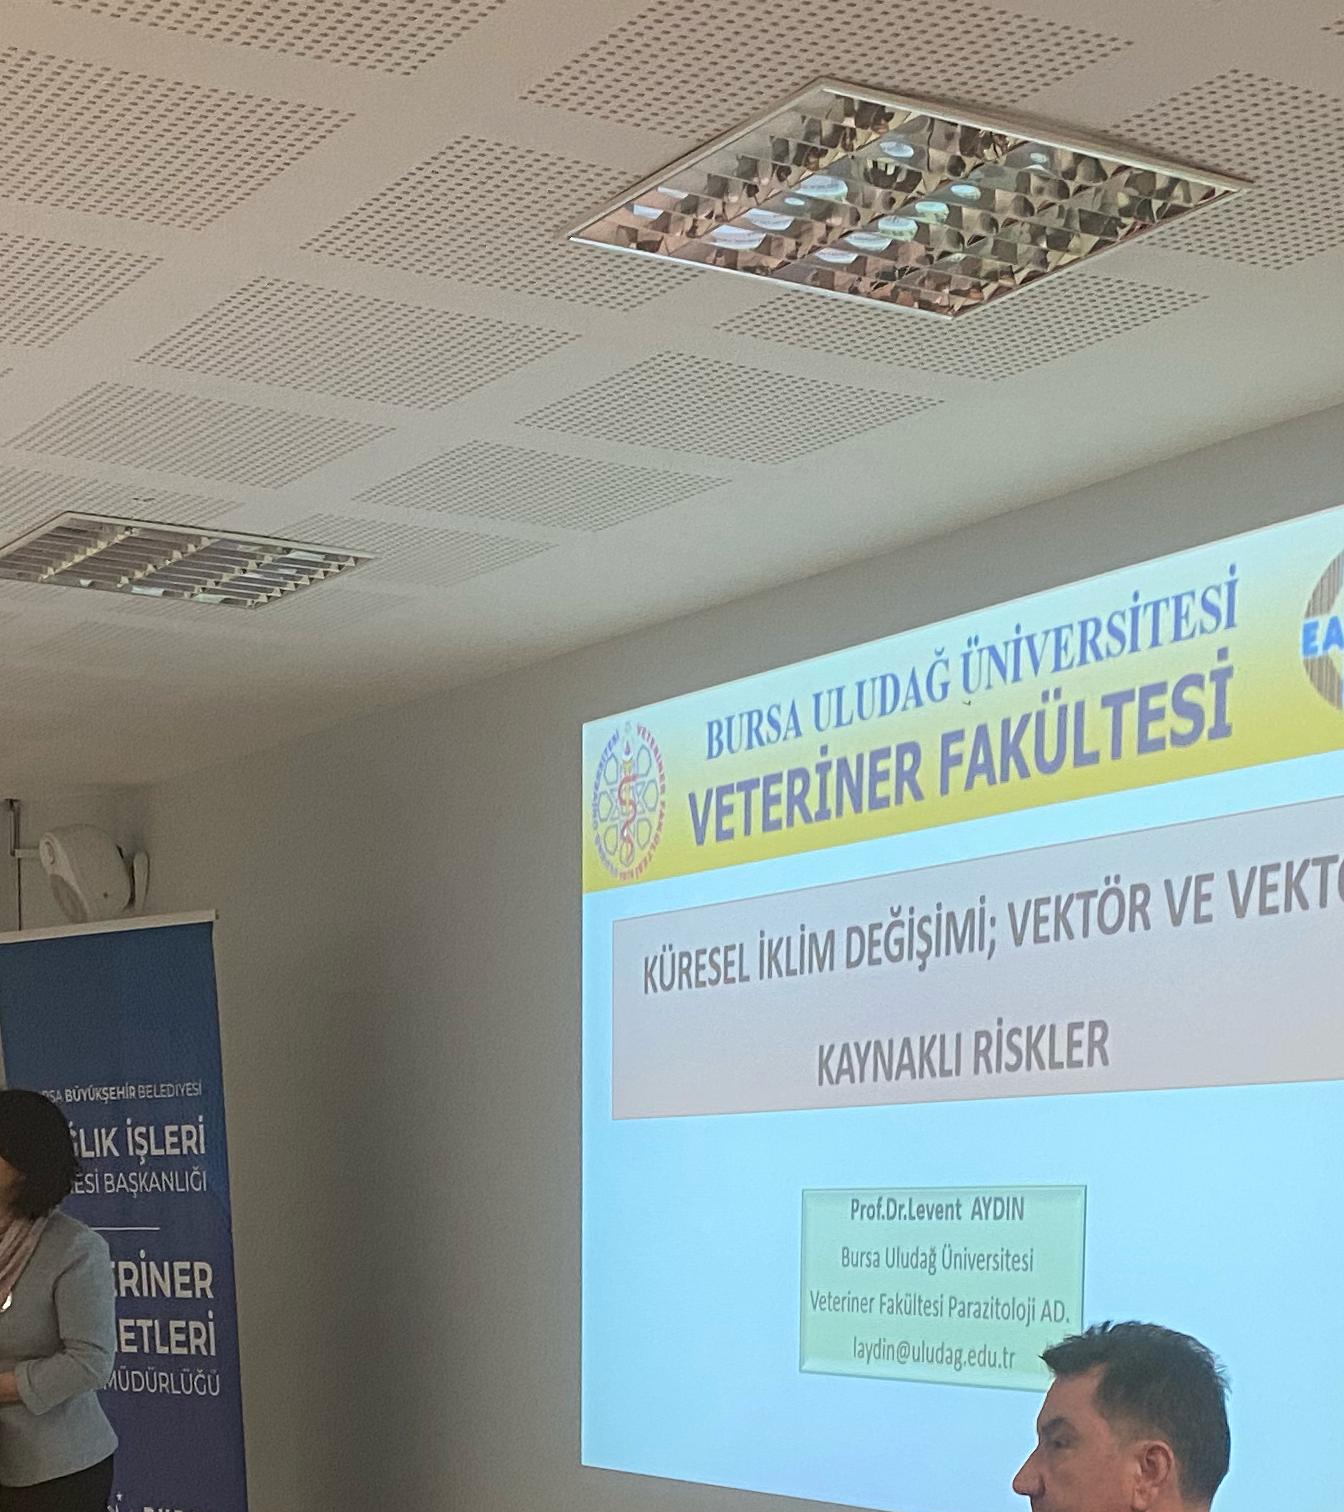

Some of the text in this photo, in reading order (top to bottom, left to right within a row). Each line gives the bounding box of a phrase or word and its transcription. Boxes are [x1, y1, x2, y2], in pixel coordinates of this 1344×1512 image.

[705, 563, 1239, 761] BURSA ULUDAĞ ÜNİVERSİTESİ
[688, 646, 1234, 847] VETERİNER FAKÜLTESİ
[644, 944, 750, 994] KÜRESEL
[759, 923, 835, 980] İKLİM
[845, 895, 997, 972] DEĞİŞİMİ;
[1007, 874, 1152, 948] VEKTÖR
[1164, 872, 1215, 927] VE
[817, 1017, 1110, 1087] KAYNAKLI RİSKLER
[41, 1089, 63, 1103] RSA
[65, 1082, 136, 1104] BÜYÜKŞEHİR
[69, 1115, 206, 1165] LIK İŞLERİ
[106, 1166, 207, 1199] BAŞKANLIĞI
[850, 1196, 1025, 1221] Prof.Dr.Levent AYDIN
[110, 1249, 214, 1298] RİNER
[841, 1244, 1034, 1275] Bursa Uludağ Üniversitesi
[810, 1290, 1070, 1327] Veteriner Fakültesi Parazitoloji AD.
[115, 1310, 216, 1356] ETLERİ
[853, 1336, 1016, 1371] laydin@uludag.edu.tr
